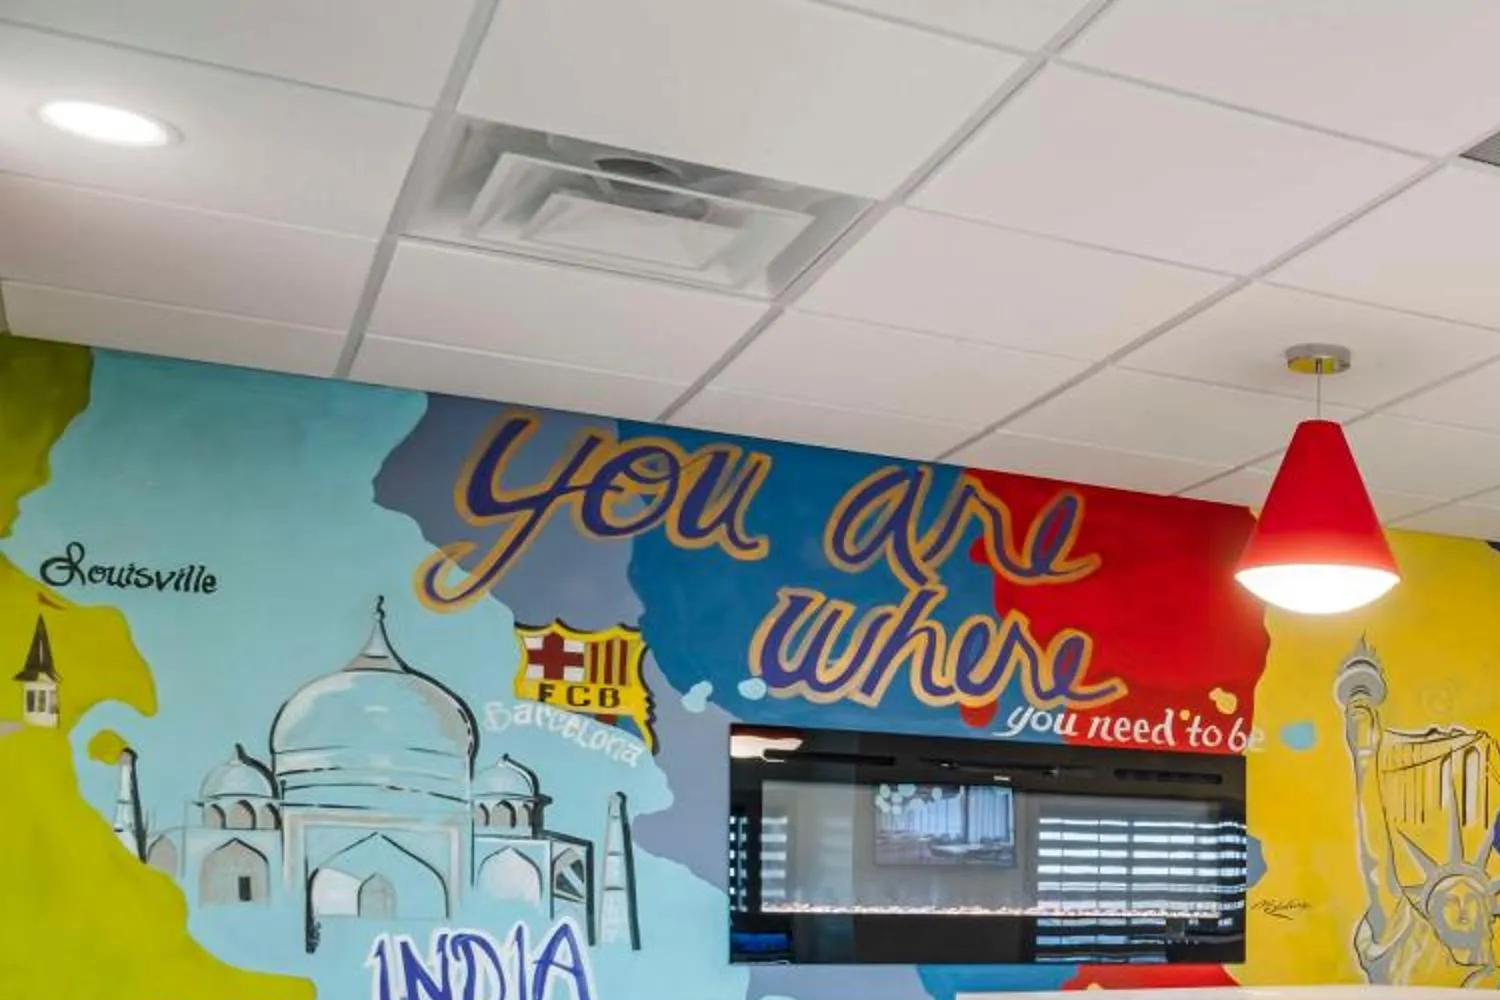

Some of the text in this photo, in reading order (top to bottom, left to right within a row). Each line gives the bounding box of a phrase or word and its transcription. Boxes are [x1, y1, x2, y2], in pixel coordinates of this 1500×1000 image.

[40, 541, 217, 593] Louisville
[824, 462, 1101, 588] are
[750, 585, 1128, 708] where
[992, 704, 1266, 753] you need to be
